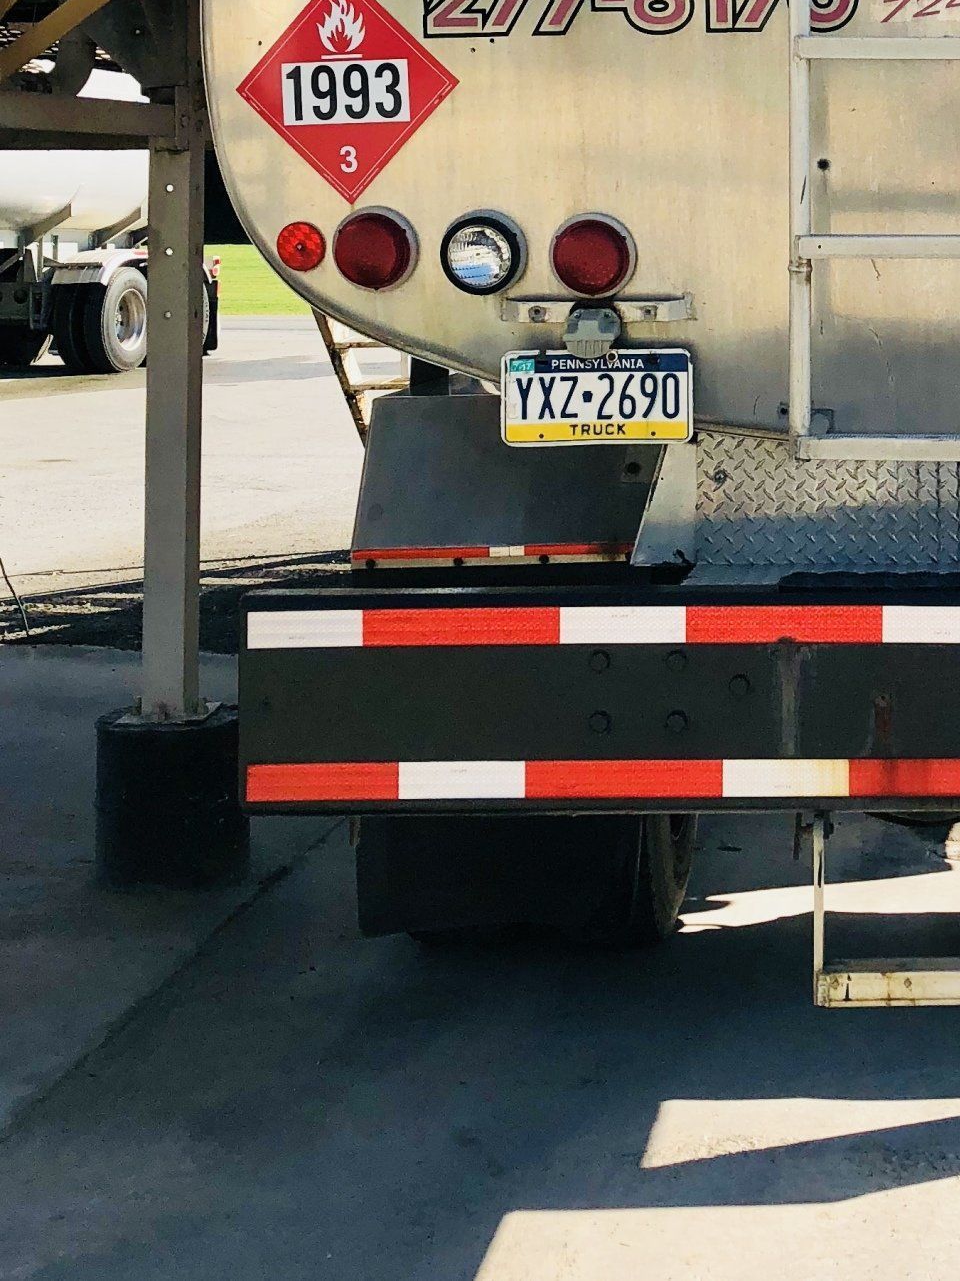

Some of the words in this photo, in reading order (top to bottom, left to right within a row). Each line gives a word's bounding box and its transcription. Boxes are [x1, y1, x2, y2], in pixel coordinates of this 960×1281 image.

[285, 61, 403, 121] 1993
[339, 144, 359, 173] 3
[551, 359, 645, 370] PENNSYLVANIA
[569, 423, 627, 436] TRUCK
